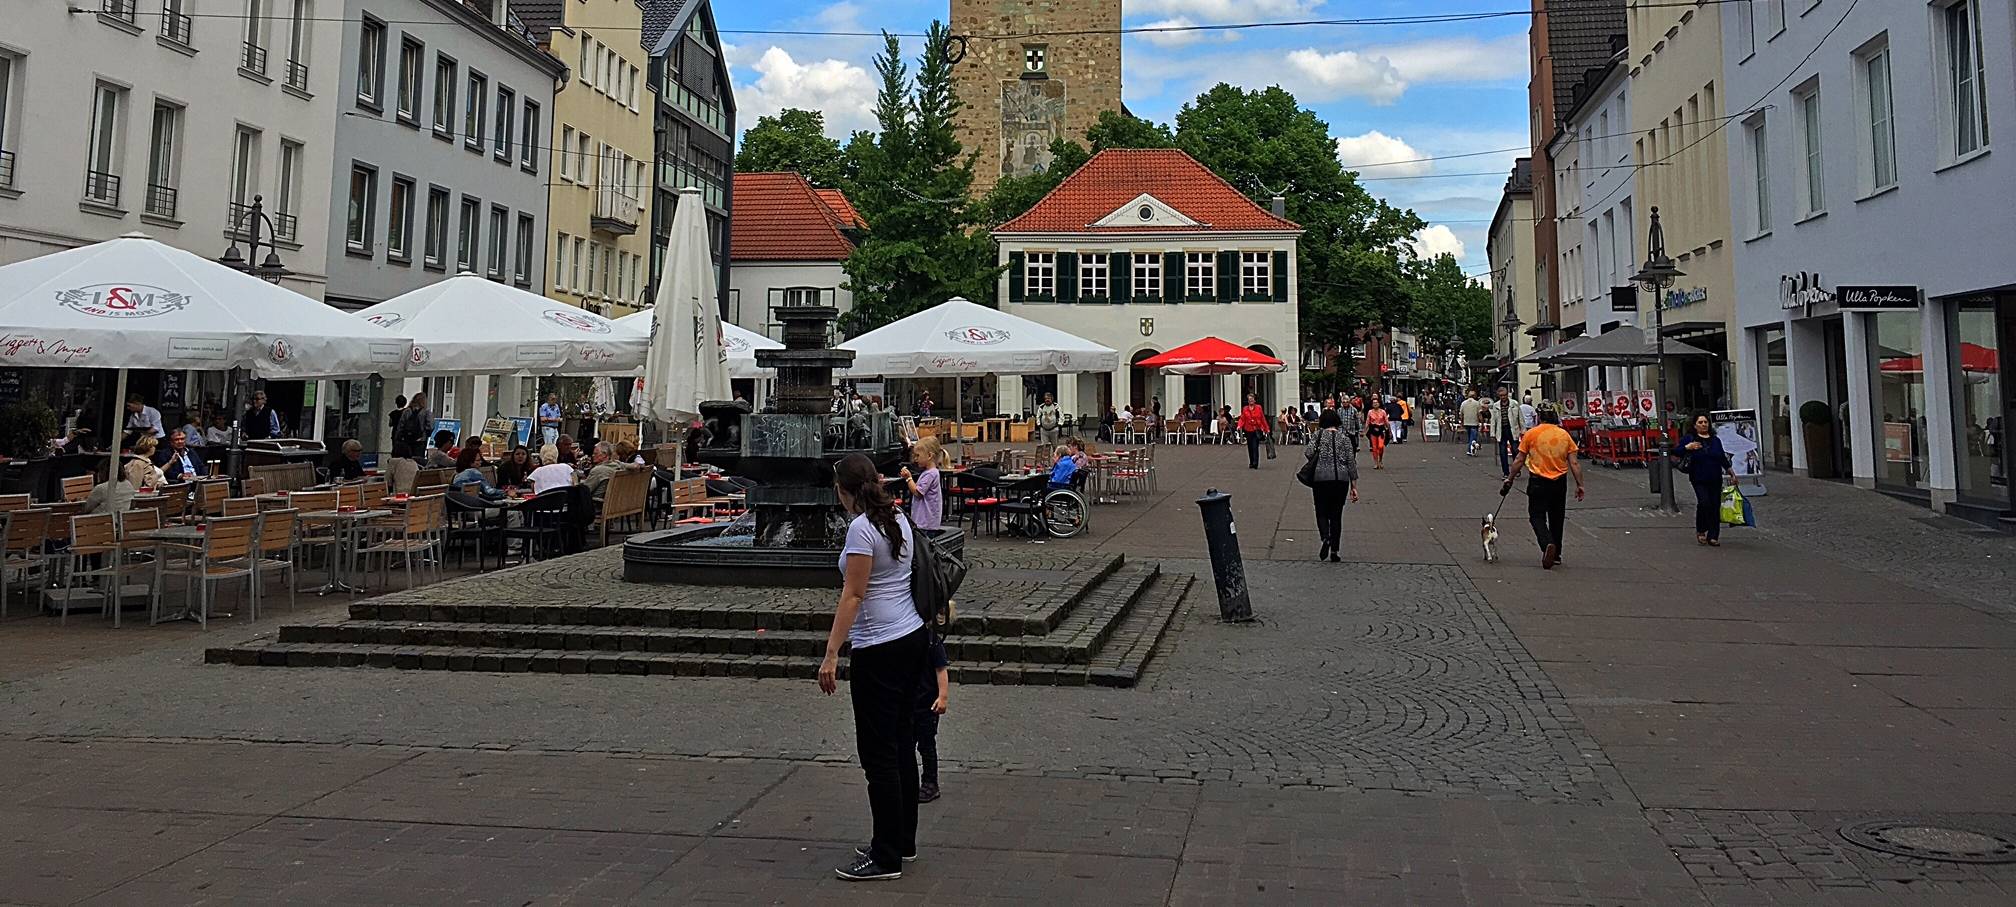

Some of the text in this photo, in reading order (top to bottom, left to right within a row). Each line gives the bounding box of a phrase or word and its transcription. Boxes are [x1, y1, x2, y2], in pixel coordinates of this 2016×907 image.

[92, 287, 155, 310] L&M
[1845, 289, 1912, 306] Ulla Popken
